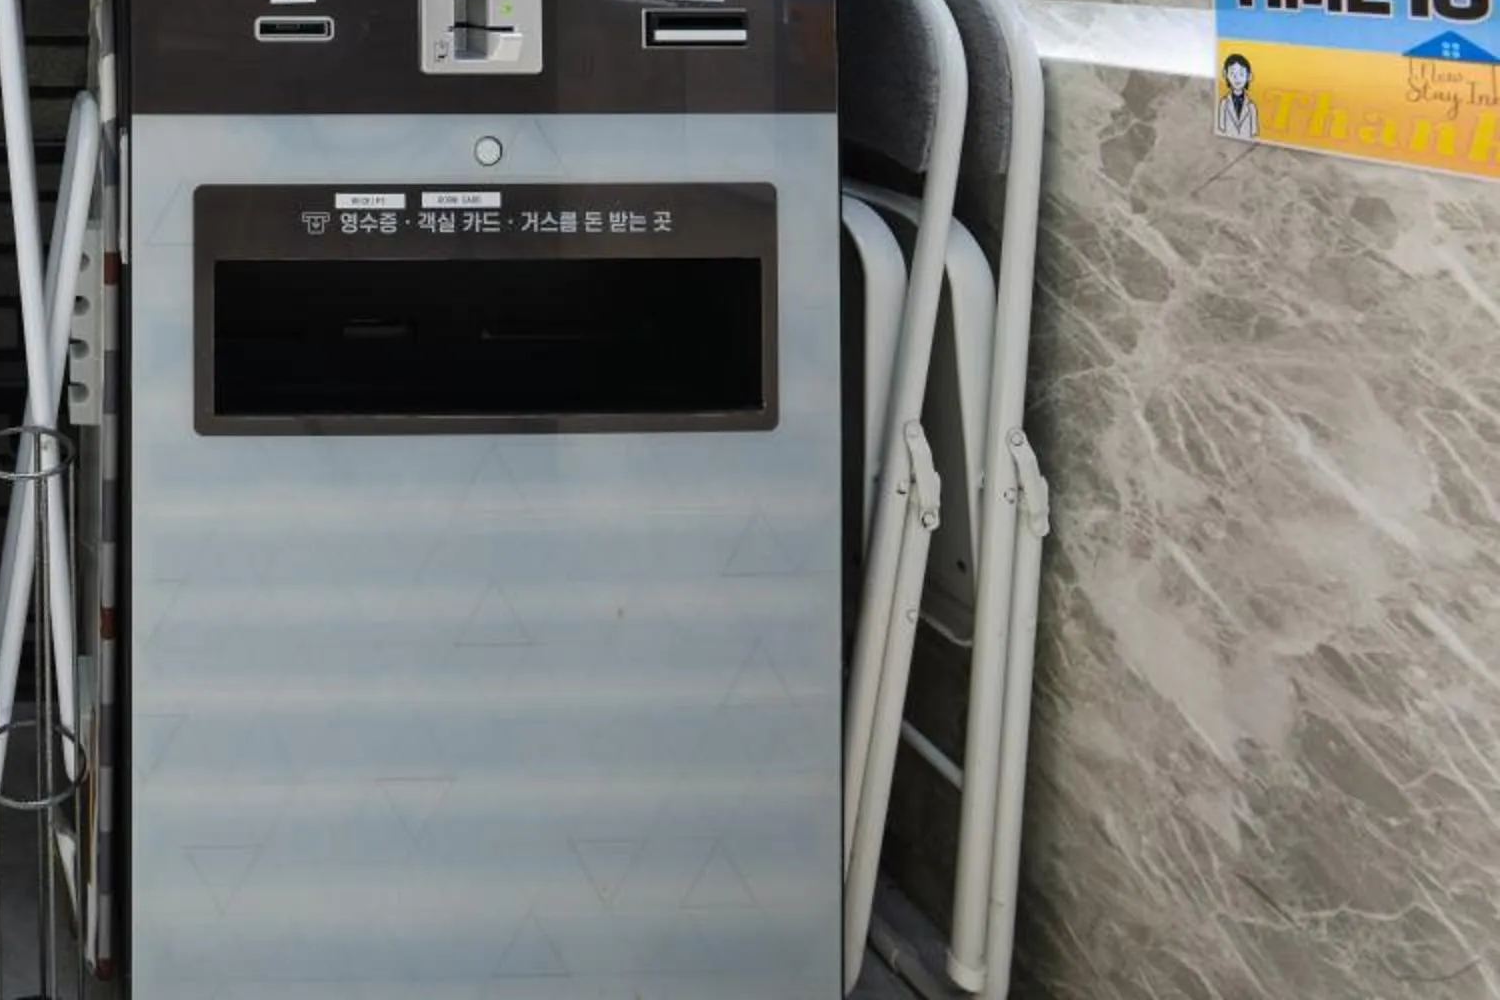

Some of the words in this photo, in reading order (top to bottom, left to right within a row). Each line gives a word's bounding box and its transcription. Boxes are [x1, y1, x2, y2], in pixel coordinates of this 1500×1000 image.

[341, 212, 398, 234] 영수증
[417, 212, 455, 233] 객실
[463, 211, 501, 233] 카드
[608, 211, 647, 233] 받는
[653, 211, 673, 232] 곳
